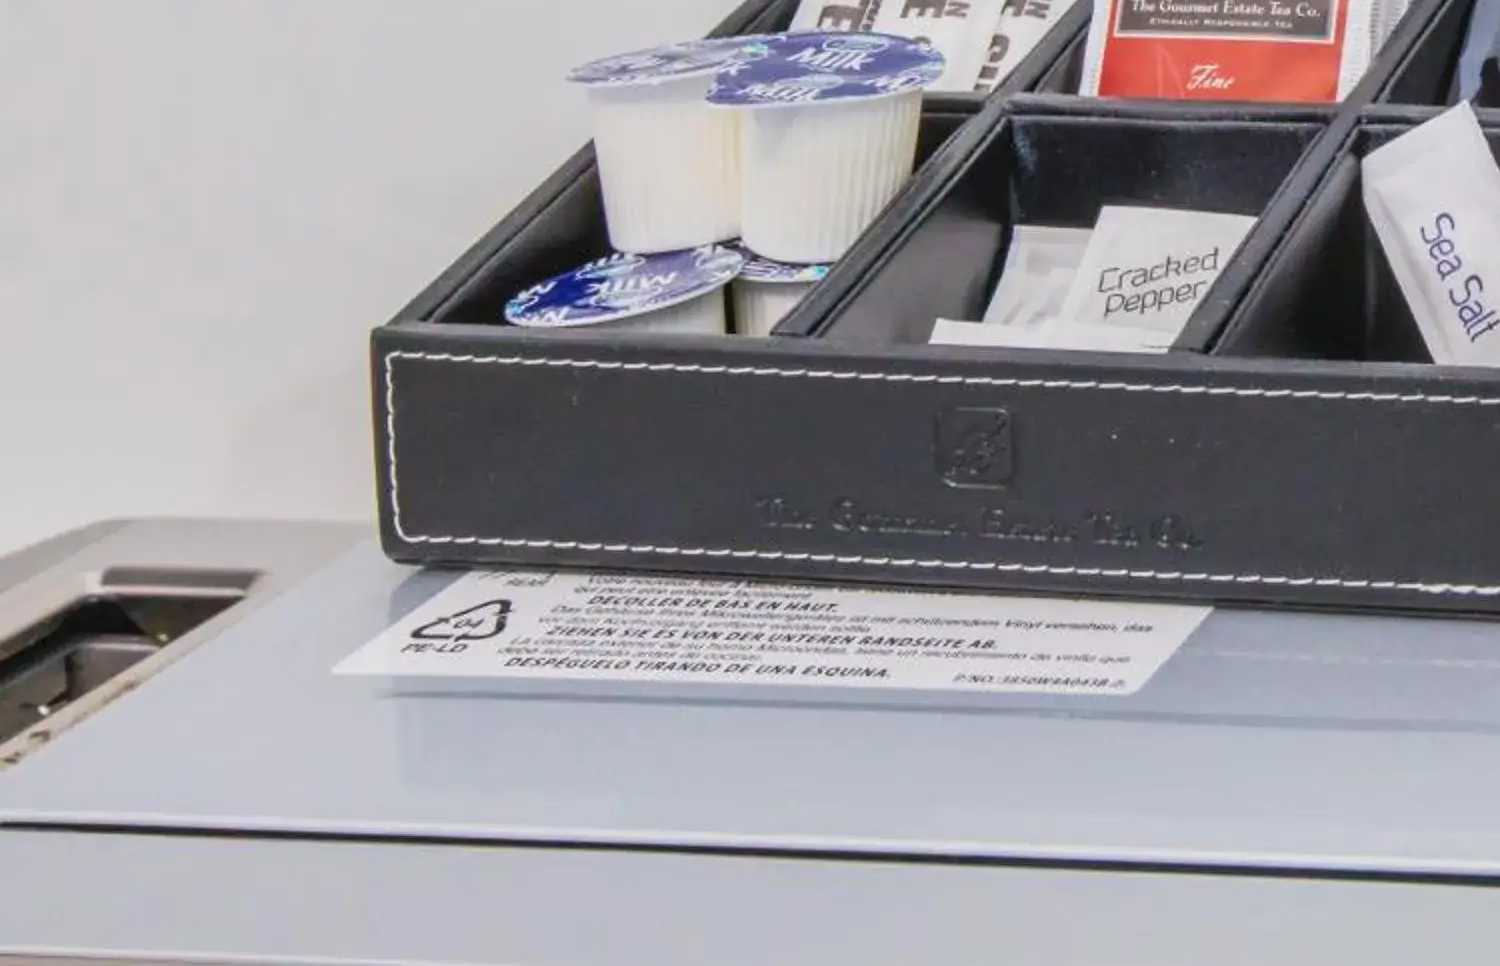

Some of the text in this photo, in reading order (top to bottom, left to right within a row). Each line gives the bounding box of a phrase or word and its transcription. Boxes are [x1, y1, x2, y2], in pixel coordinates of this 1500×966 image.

[1222, 0, 1265, 15] Estate
[1268, 0, 1292, 16] Tea
[1295, 2, 1321, 18] Co.
[786, 46, 876, 72] Milk
[1097, 246, 1219, 293] Cracked
[1420, 212, 1500, 343] Sea Salt
[1103, 280, 1207, 318] Pepper
[633, 660, 723, 672] TIRANDO
[723, 662, 755, 673] DE
[755, 664, 799, 675] UNA
